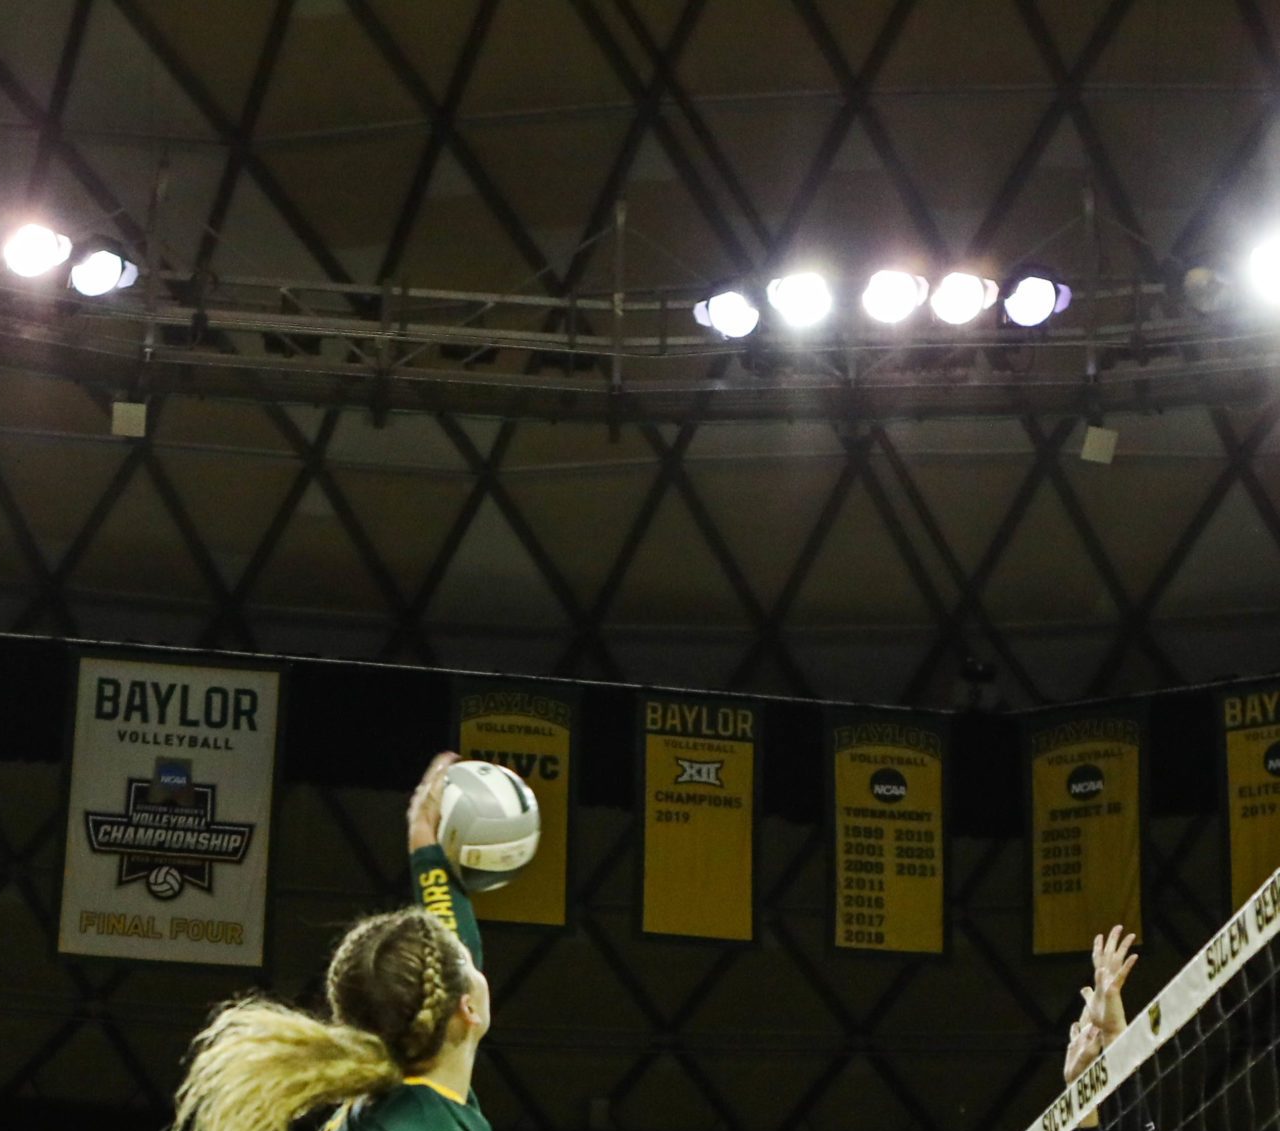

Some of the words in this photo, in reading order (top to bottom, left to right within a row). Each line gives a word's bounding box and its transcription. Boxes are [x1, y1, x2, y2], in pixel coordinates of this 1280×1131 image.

[95, 677, 258, 732] BAYLOR
[462, 692, 572, 729] BAYLOR
[1224, 691, 1280, 729] BAY
[476, 721, 556, 738] VOLLEYBALL
[645, 701, 754, 739] BAYLOR
[118, 730, 234, 751] VOLLEYBALL
[663, 739, 737, 754] VOLLEYBALL
[849, 753, 928, 767] VOLLEYBALL
[874, 785, 907, 796] NCAA
[1071, 780, 1104, 794] NCAA
[654, 790, 743, 810] CHAMPIONS
[131, 811, 208, 831] VOLLEYBALL
[655, 810, 690, 824] 2019
[843, 806, 933, 822] TOURNAMENT
[98, 823, 244, 853] CHAMPIONSHIP
[896, 862, 936, 878] 2021
[844, 877, 885, 892] 2011
[79, 910, 164, 941] FINAL
[169, 917, 245, 945] FOUR
[844, 912, 886, 927] 2017
[1206, 916, 1249, 981] SIC'EM
[1255, 872, 1280, 935] BEA
[1077, 1054, 1110, 1110] BEARS
